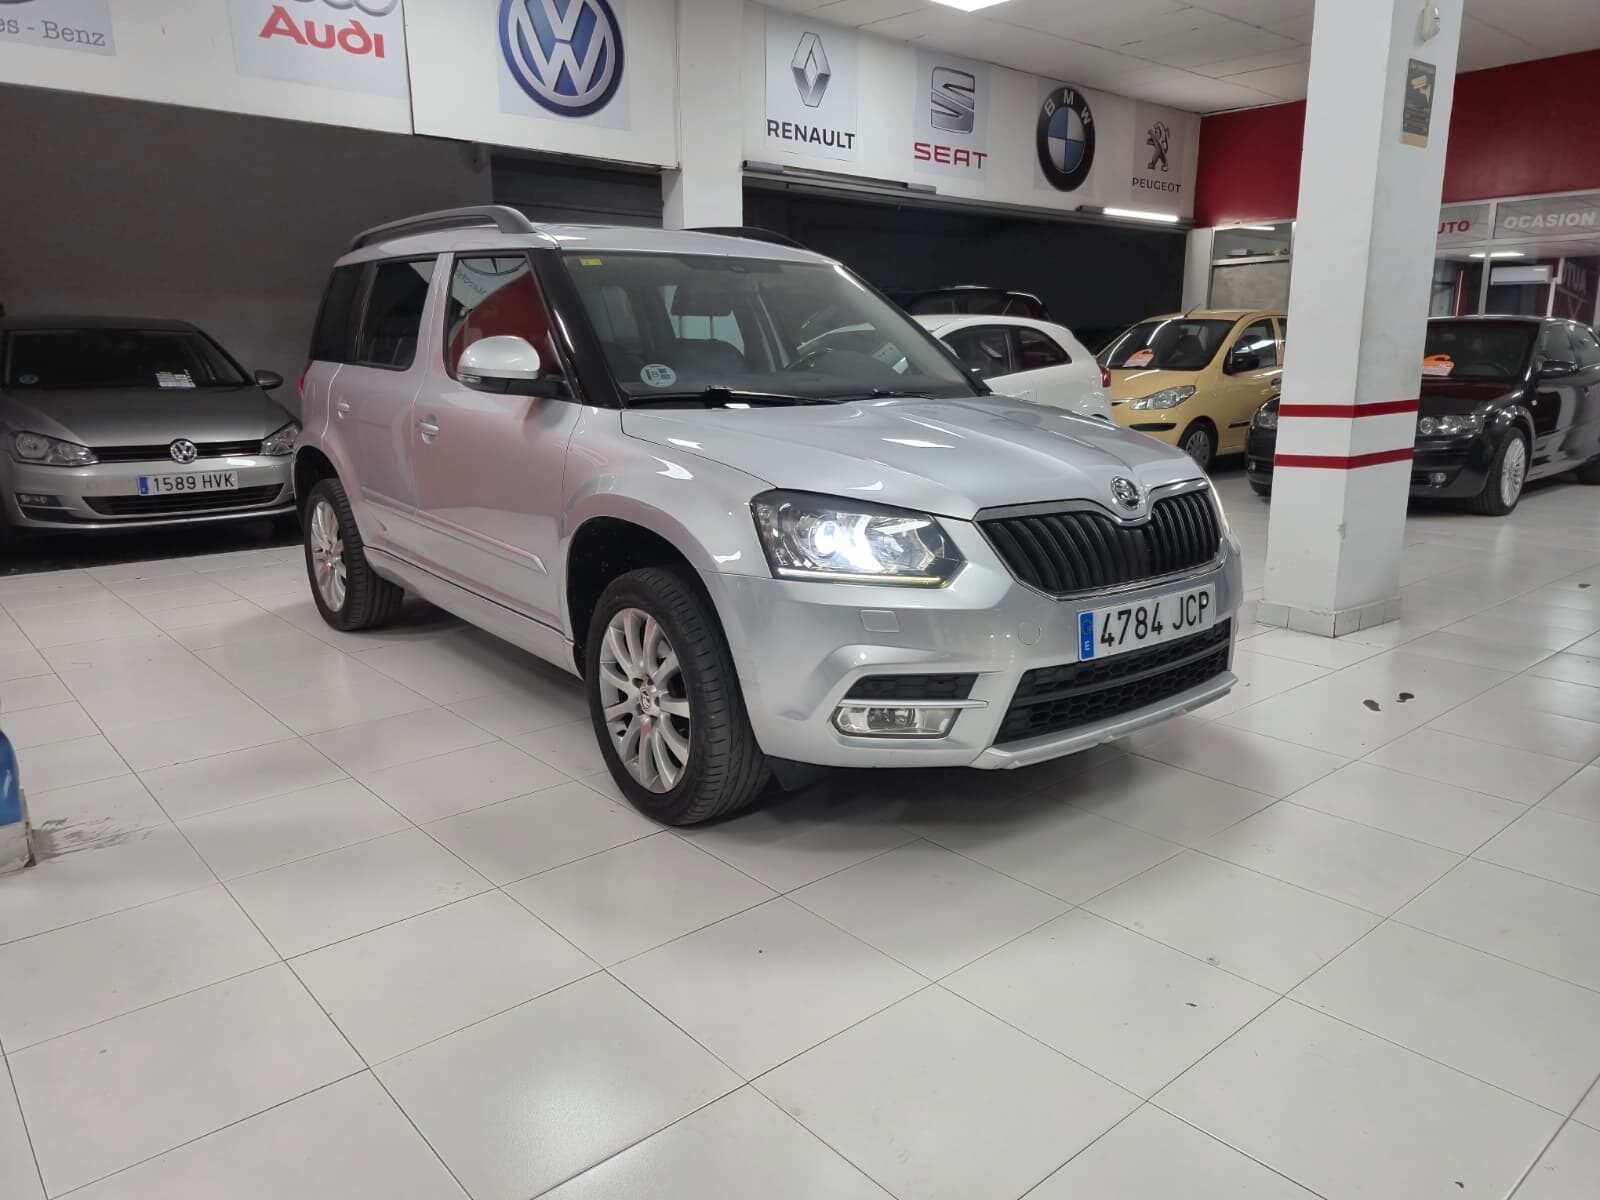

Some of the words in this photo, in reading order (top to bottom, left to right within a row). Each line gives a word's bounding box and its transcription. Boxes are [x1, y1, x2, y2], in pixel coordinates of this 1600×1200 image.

[41, 20, 105, 47] Benz
[259, 5, 385, 58] Audi
[1044, 88, 1091, 125] BMW
[767, 119, 855, 150] RENAULT
[914, 142, 988, 169] SEAT
[1132, 177, 1182, 193] PEUGEOT
[1503, 211, 1596, 229] OCASION
[153, 475, 196, 493] 1589
[202, 473, 234, 489] HVK
[1084, 641, 1090, 651] E
[1100, 602, 1163, 647] 4784
[1172, 591, 1209, 630] JCP
